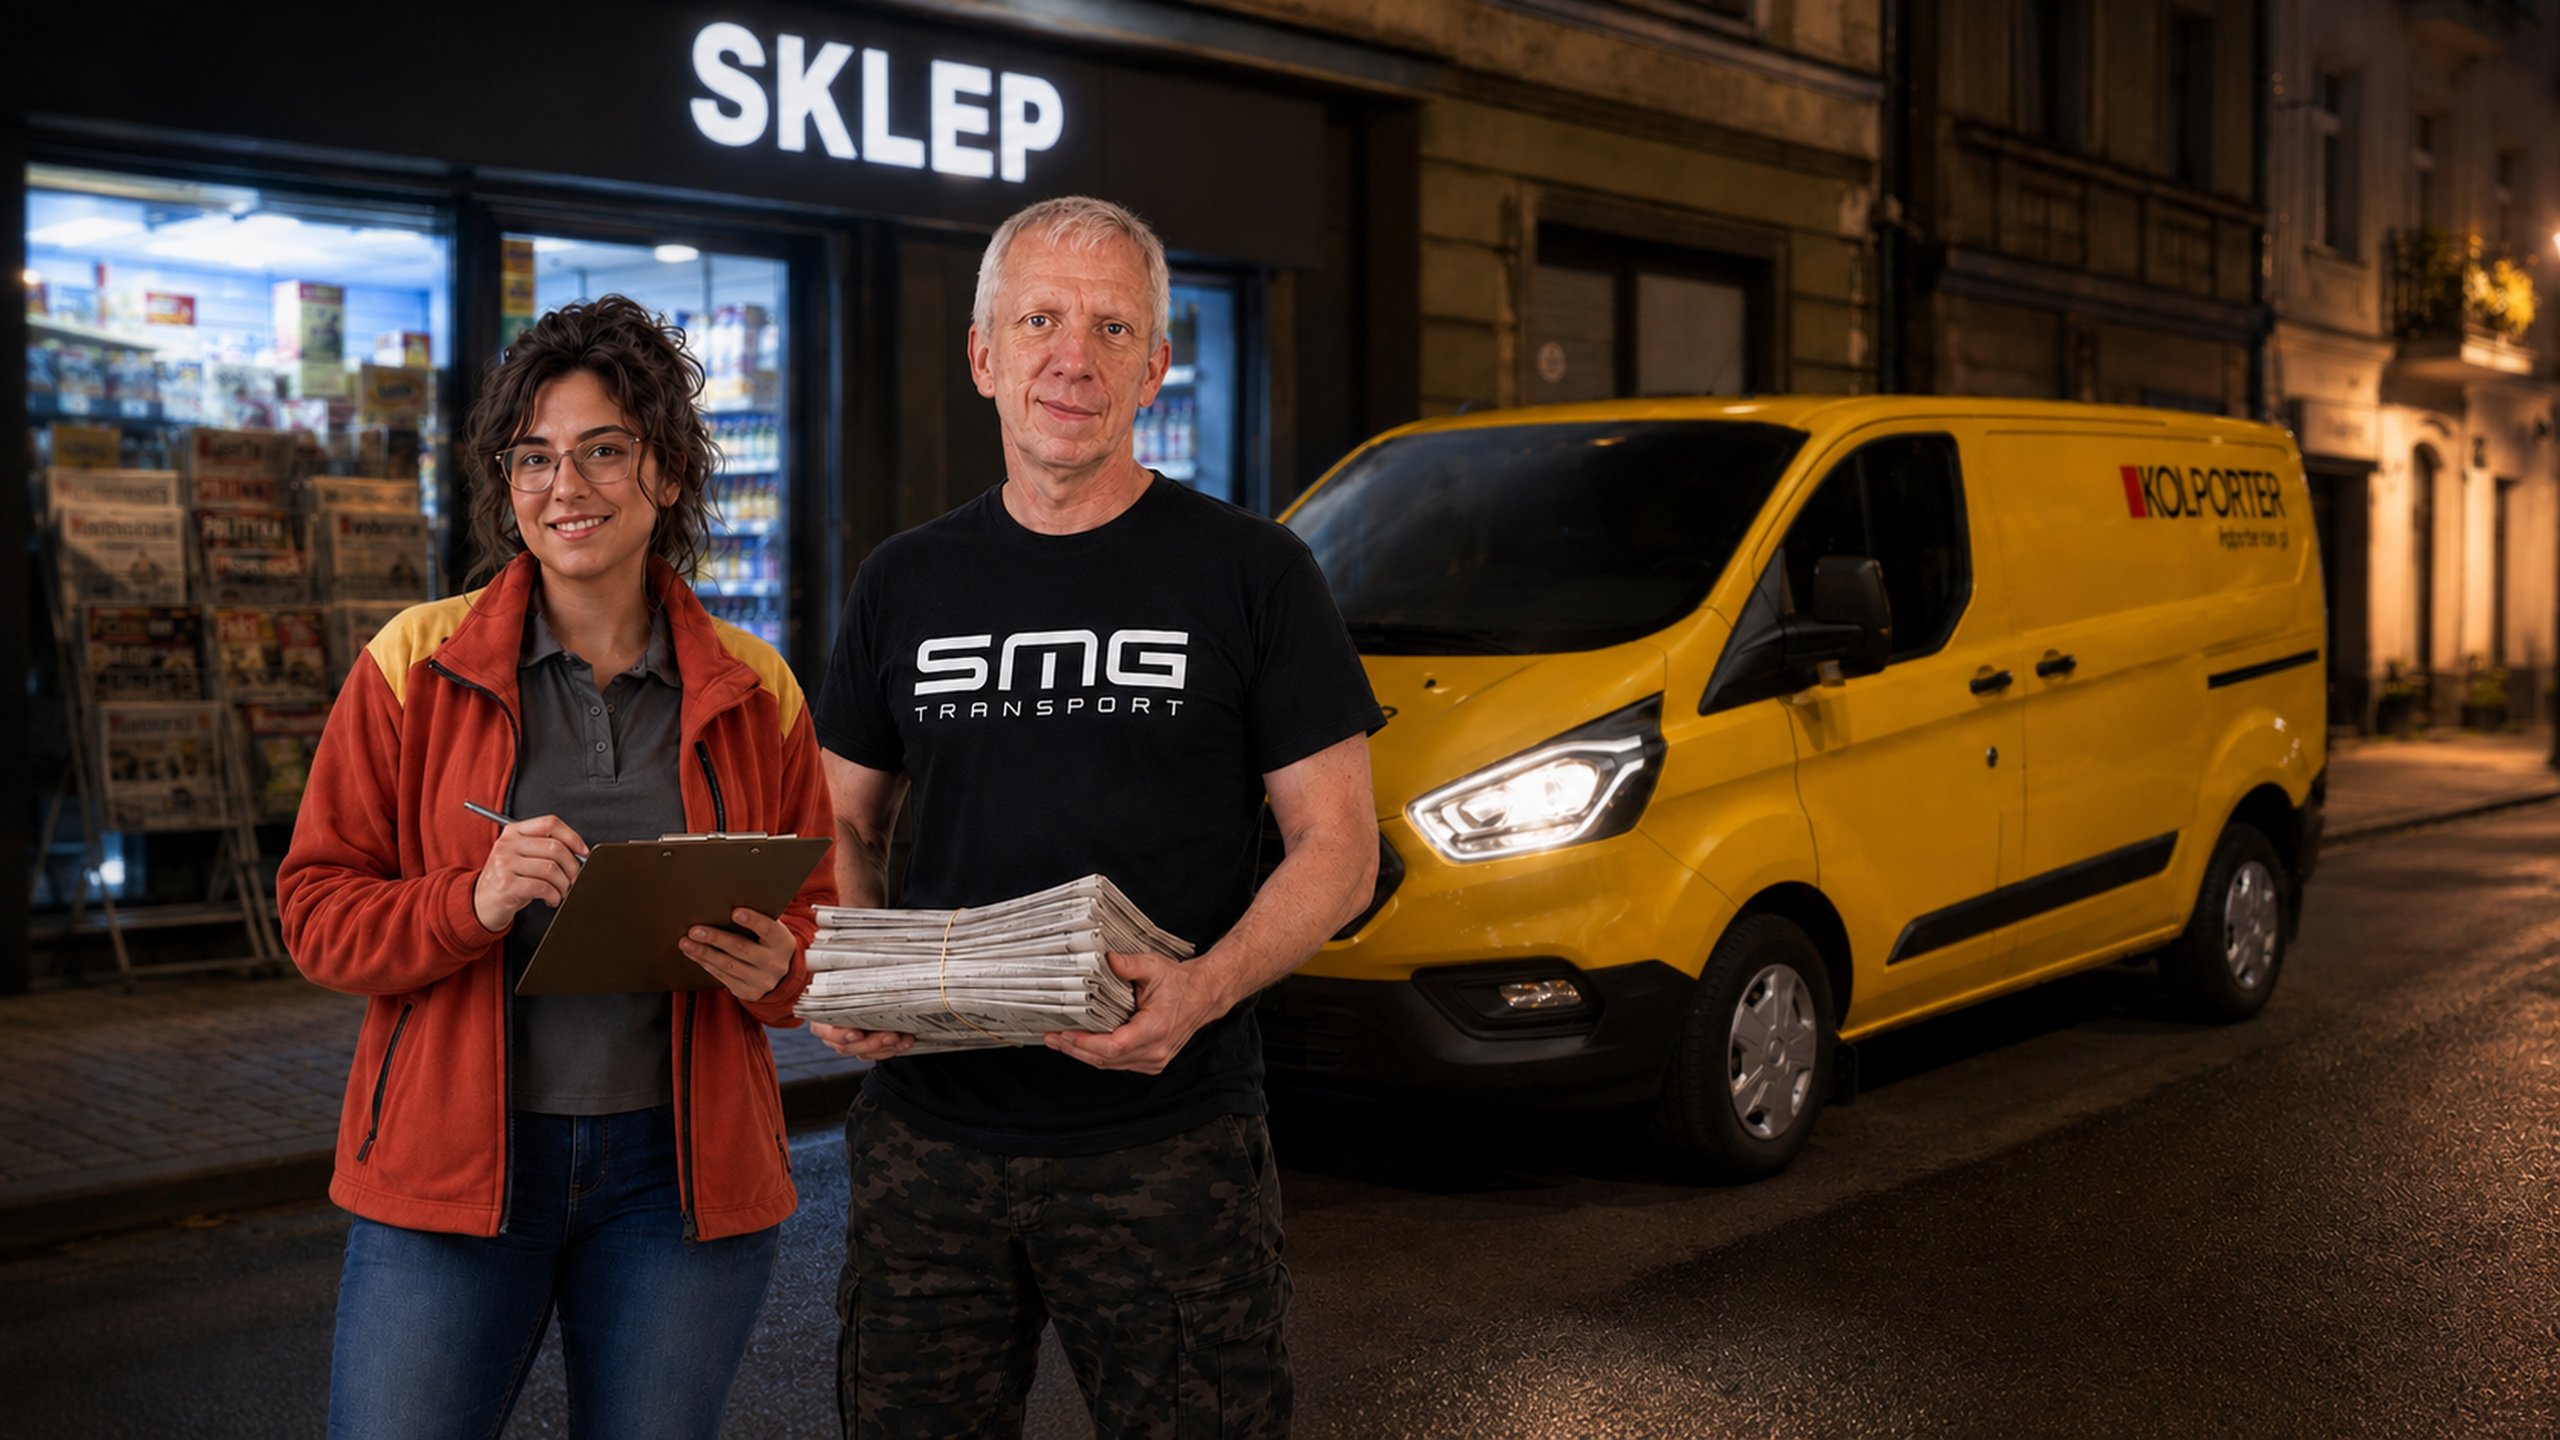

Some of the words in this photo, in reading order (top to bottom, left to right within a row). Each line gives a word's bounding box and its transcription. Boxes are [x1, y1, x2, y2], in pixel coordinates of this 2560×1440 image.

[690, 22, 1064, 183] SKLEP
[2138, 465, 2287, 518] KOLPORTER
[914, 629, 1189, 696] SMG
[915, 697, 1184, 722] TRANSPORT
